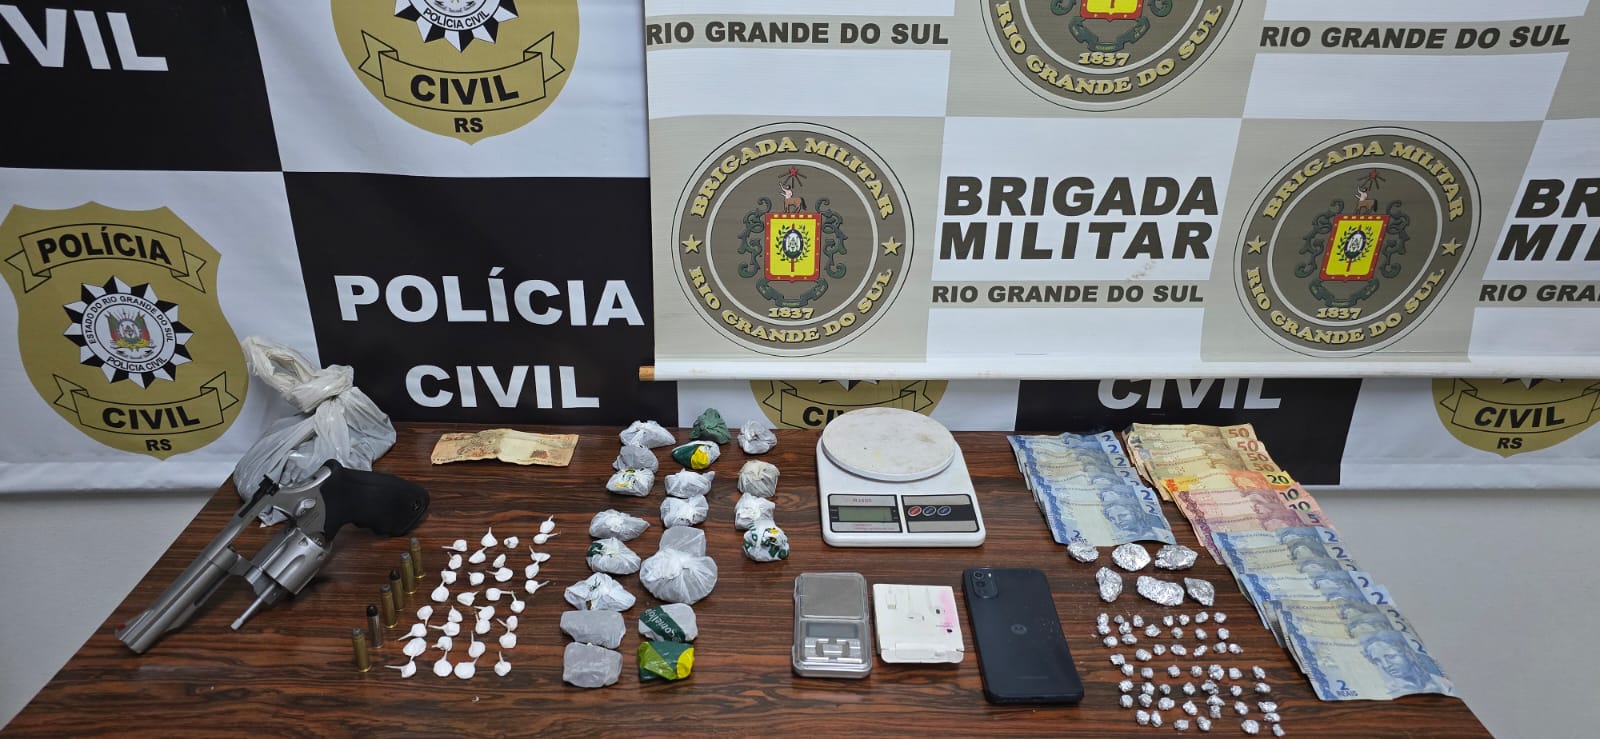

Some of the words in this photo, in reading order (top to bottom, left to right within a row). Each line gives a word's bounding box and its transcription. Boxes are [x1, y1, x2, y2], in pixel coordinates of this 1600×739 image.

[423, 7, 464, 29] POLÍCIA
[465, 10, 490, 28] CIVIL
[0, 4, 169, 71] VIL
[646, 21, 695, 46] RIO
[705, 21, 829, 44] GRANDE
[840, 22, 881, 45] DO
[890, 23, 949, 45] SUL
[1259, 26, 1311, 47] RIO
[1321, 26, 1448, 48] GRANDE
[1454, 27, 1500, 49] DO
[1508, 23, 1570, 48] SUL
[996, 1, 1027, 54] RIO
[1025, 54, 1133, 95] GRANDE
[1137, 58, 1176, 87] DO
[1178, 5, 1224, 60] SUL
[1078, 52, 1130, 66] 1837
[410, 74, 519, 105] CIVIL
[453, 117, 484, 133] RS
[691, 137, 798, 218] BRIGADA
[804, 138, 895, 220] MILITAR
[1263, 141, 1384, 220] BRIGADA
[1389, 142, 1464, 221] MILITAR
[943, 176, 1219, 216] BRIGADA
[37, 226, 172, 265] POLÍCIA
[939, 221, 1213, 260] MILITAR
[333, 266, 645, 326] POLÍCIA
[932, 285, 979, 303] RIO
[987, 285, 1098, 303] GRANDE
[1107, 285, 1144, 303] DO
[1152, 285, 1204, 303] SUL
[1478, 284, 1527, 302] RIO
[1536, 284, 1600, 302] GRA
[689, 266, 721, 311] RIO
[722, 308, 820, 344] GRANDE
[824, 313, 856, 336] DO
[857, 268, 894, 314] SUL
[1246, 266, 1271, 311] RIO
[1270, 309, 1365, 344] GRANDE
[1369, 313, 1402, 337] DO
[1406, 268, 1446, 314] SUL
[86, 313, 96, 344] ESTADO
[91, 303, 102, 313] DO
[103, 296, 117, 305] RIO
[119, 296, 157, 314] GRANDE
[157, 314, 168, 326] DO
[164, 327, 174, 342] SUL
[768, 307, 816, 320] 1837
[1316, 307, 1363, 320] 1837
[107, 357, 145, 372] POLÍCIA
[146, 358, 167, 371] CIVIL
[405, 364, 600, 409] CIVIL
[1097, 378, 1282, 410] CIVIL
[102, 405, 200, 430] CIVIL
[1474, 406, 1565, 428] CIVIL
[1102, 434, 1114, 442] 2
[1228, 427, 1250, 438] 50
[145, 439, 172, 451] RS
[1107, 444, 1120, 454] 2
[1237, 440, 1259, 452] 50
[1497, 437, 1523, 449] RS
[1115, 457, 1127, 467] 2
[1247, 452, 1269, 462] 50
[1254, 462, 1275, 472] 50
[1266, 474, 1290, 485] 20
[1141, 490, 1153, 501] 2
[1280, 488, 1300, 501] 10
[1289, 501, 1311, 512] 10
[1307, 512, 1320, 524] 5
[1073, 530, 1082, 538] 2
[1324, 531, 1339, 542] 2
[1332, 546, 1348, 558] 2
[1370, 591, 1388, 605] 2
[1410, 638, 1428, 655] 2
[1336, 679, 1350, 690] 2
